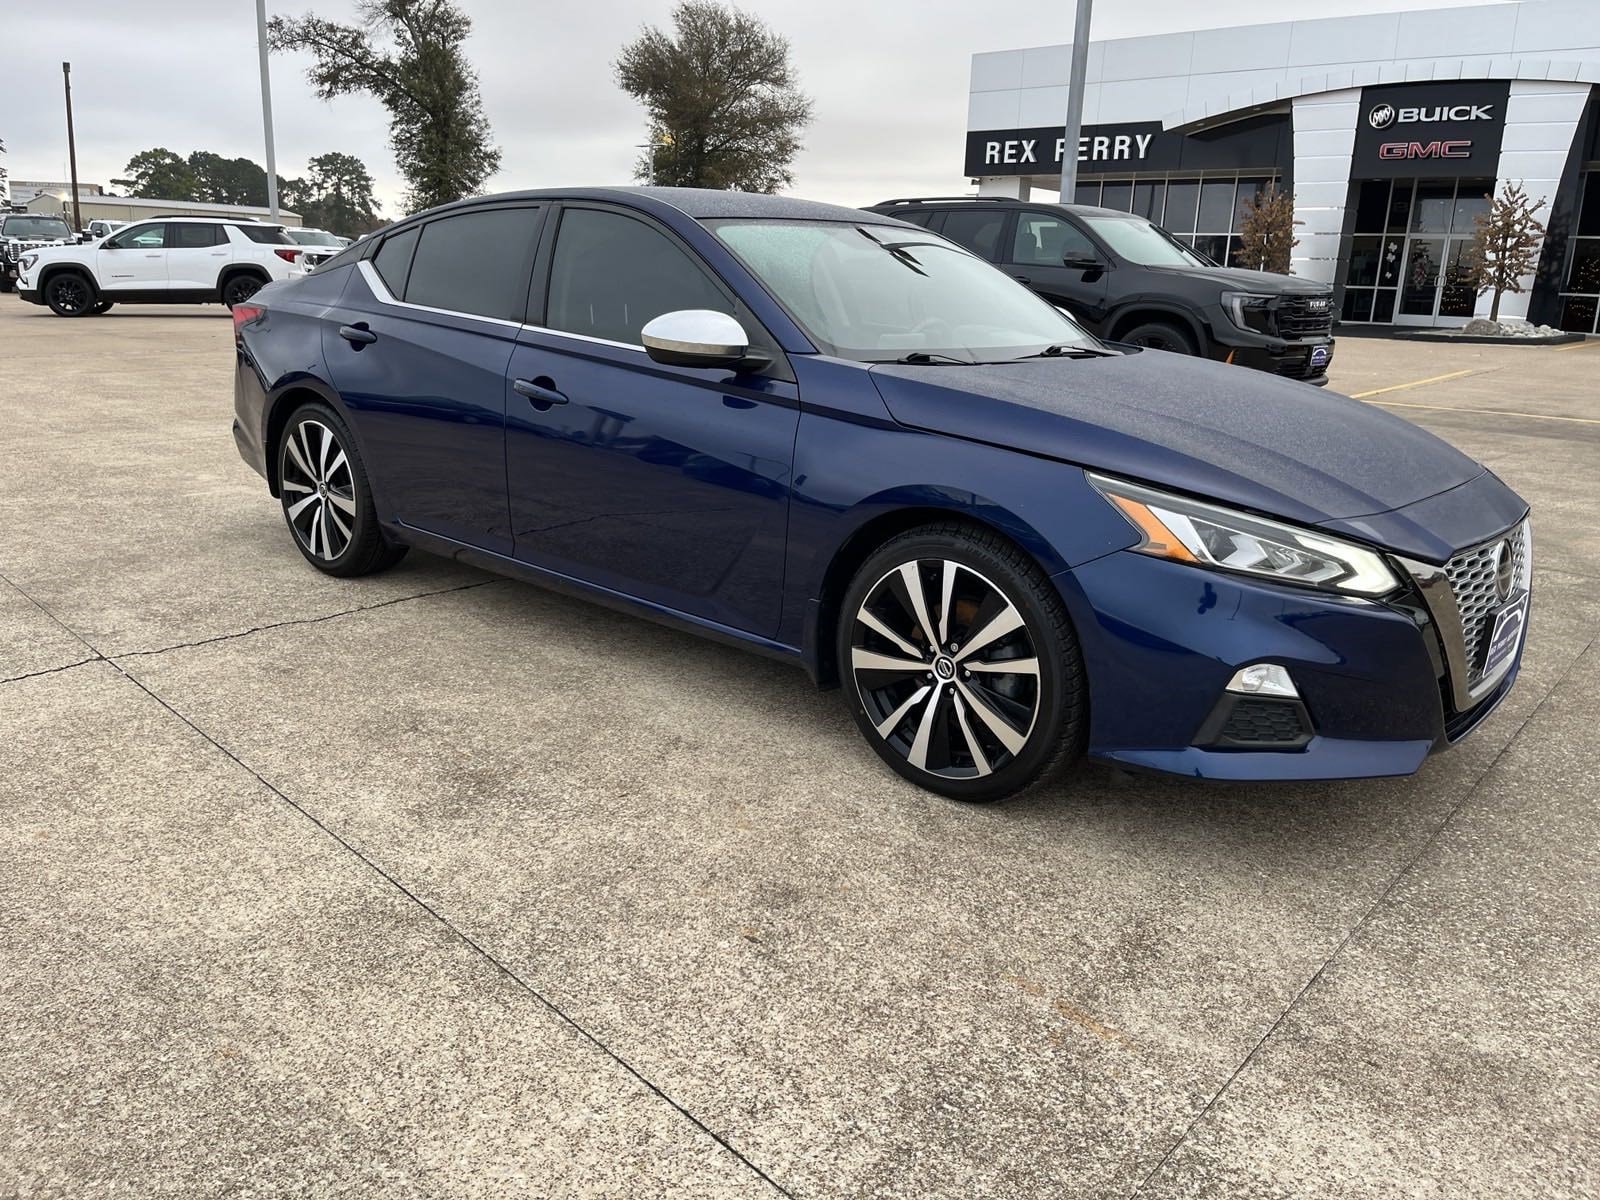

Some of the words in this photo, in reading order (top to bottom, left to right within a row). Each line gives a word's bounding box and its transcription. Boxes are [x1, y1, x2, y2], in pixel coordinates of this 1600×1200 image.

[1398, 105, 1494, 123] BUICK
[985, 139, 1037, 164] REX
[1380, 140, 1472, 159] GMC
